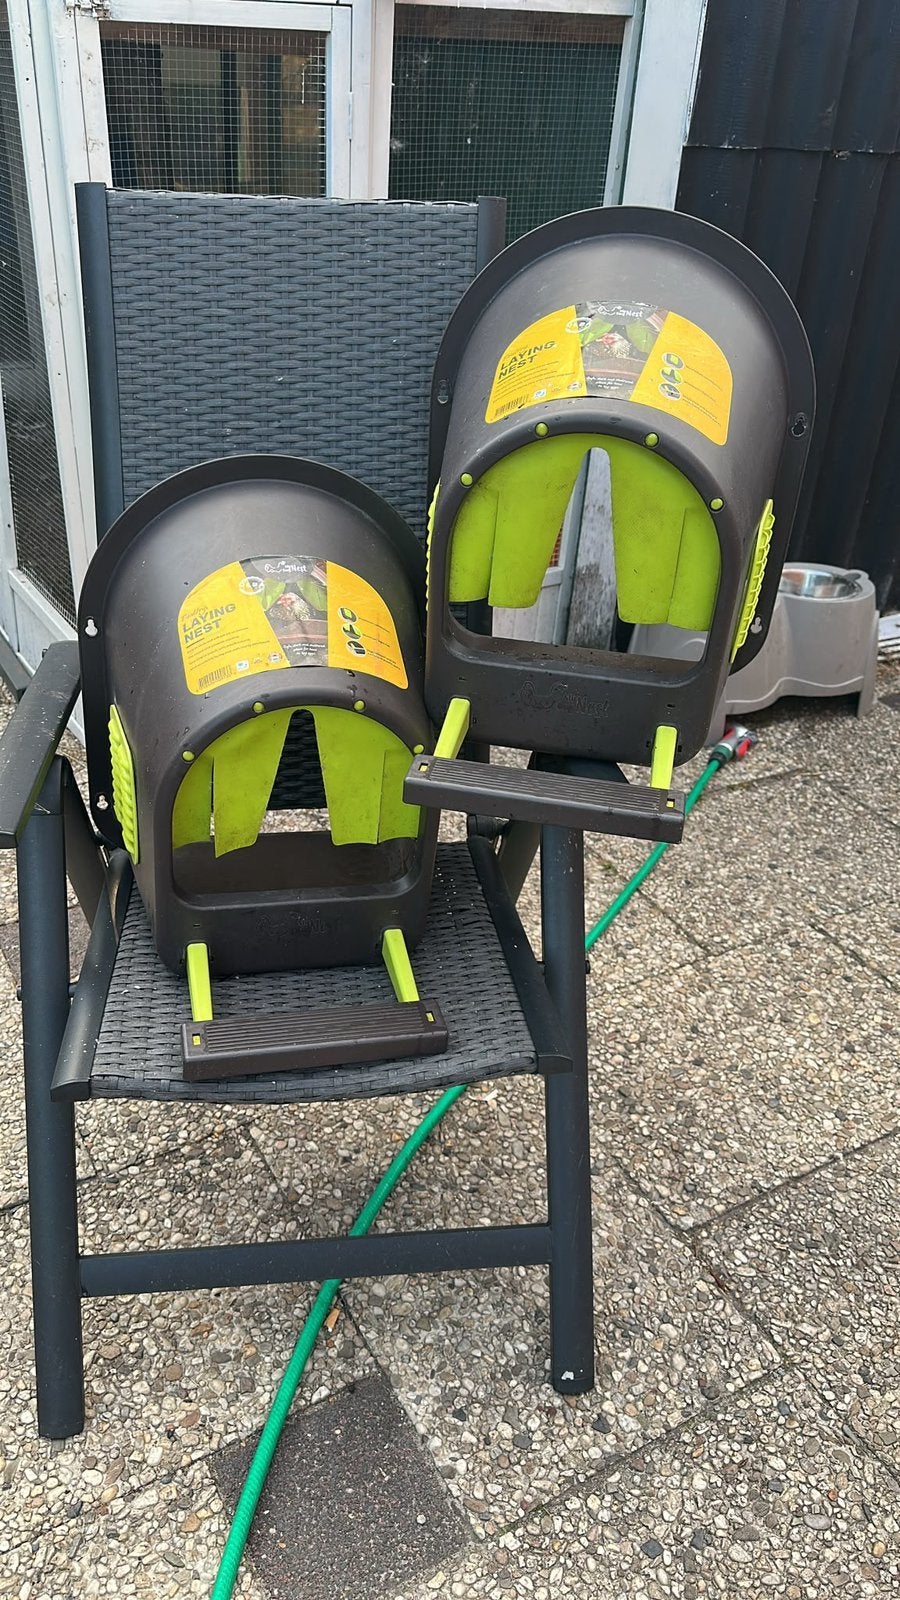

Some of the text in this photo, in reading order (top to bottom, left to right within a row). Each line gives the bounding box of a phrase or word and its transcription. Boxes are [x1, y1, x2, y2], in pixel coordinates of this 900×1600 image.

[498, 355, 537, 380] NEST
[500, 341, 556, 371] LAYING
[182, 603, 236, 633] LAYING
[184, 618, 222, 643] NEST
